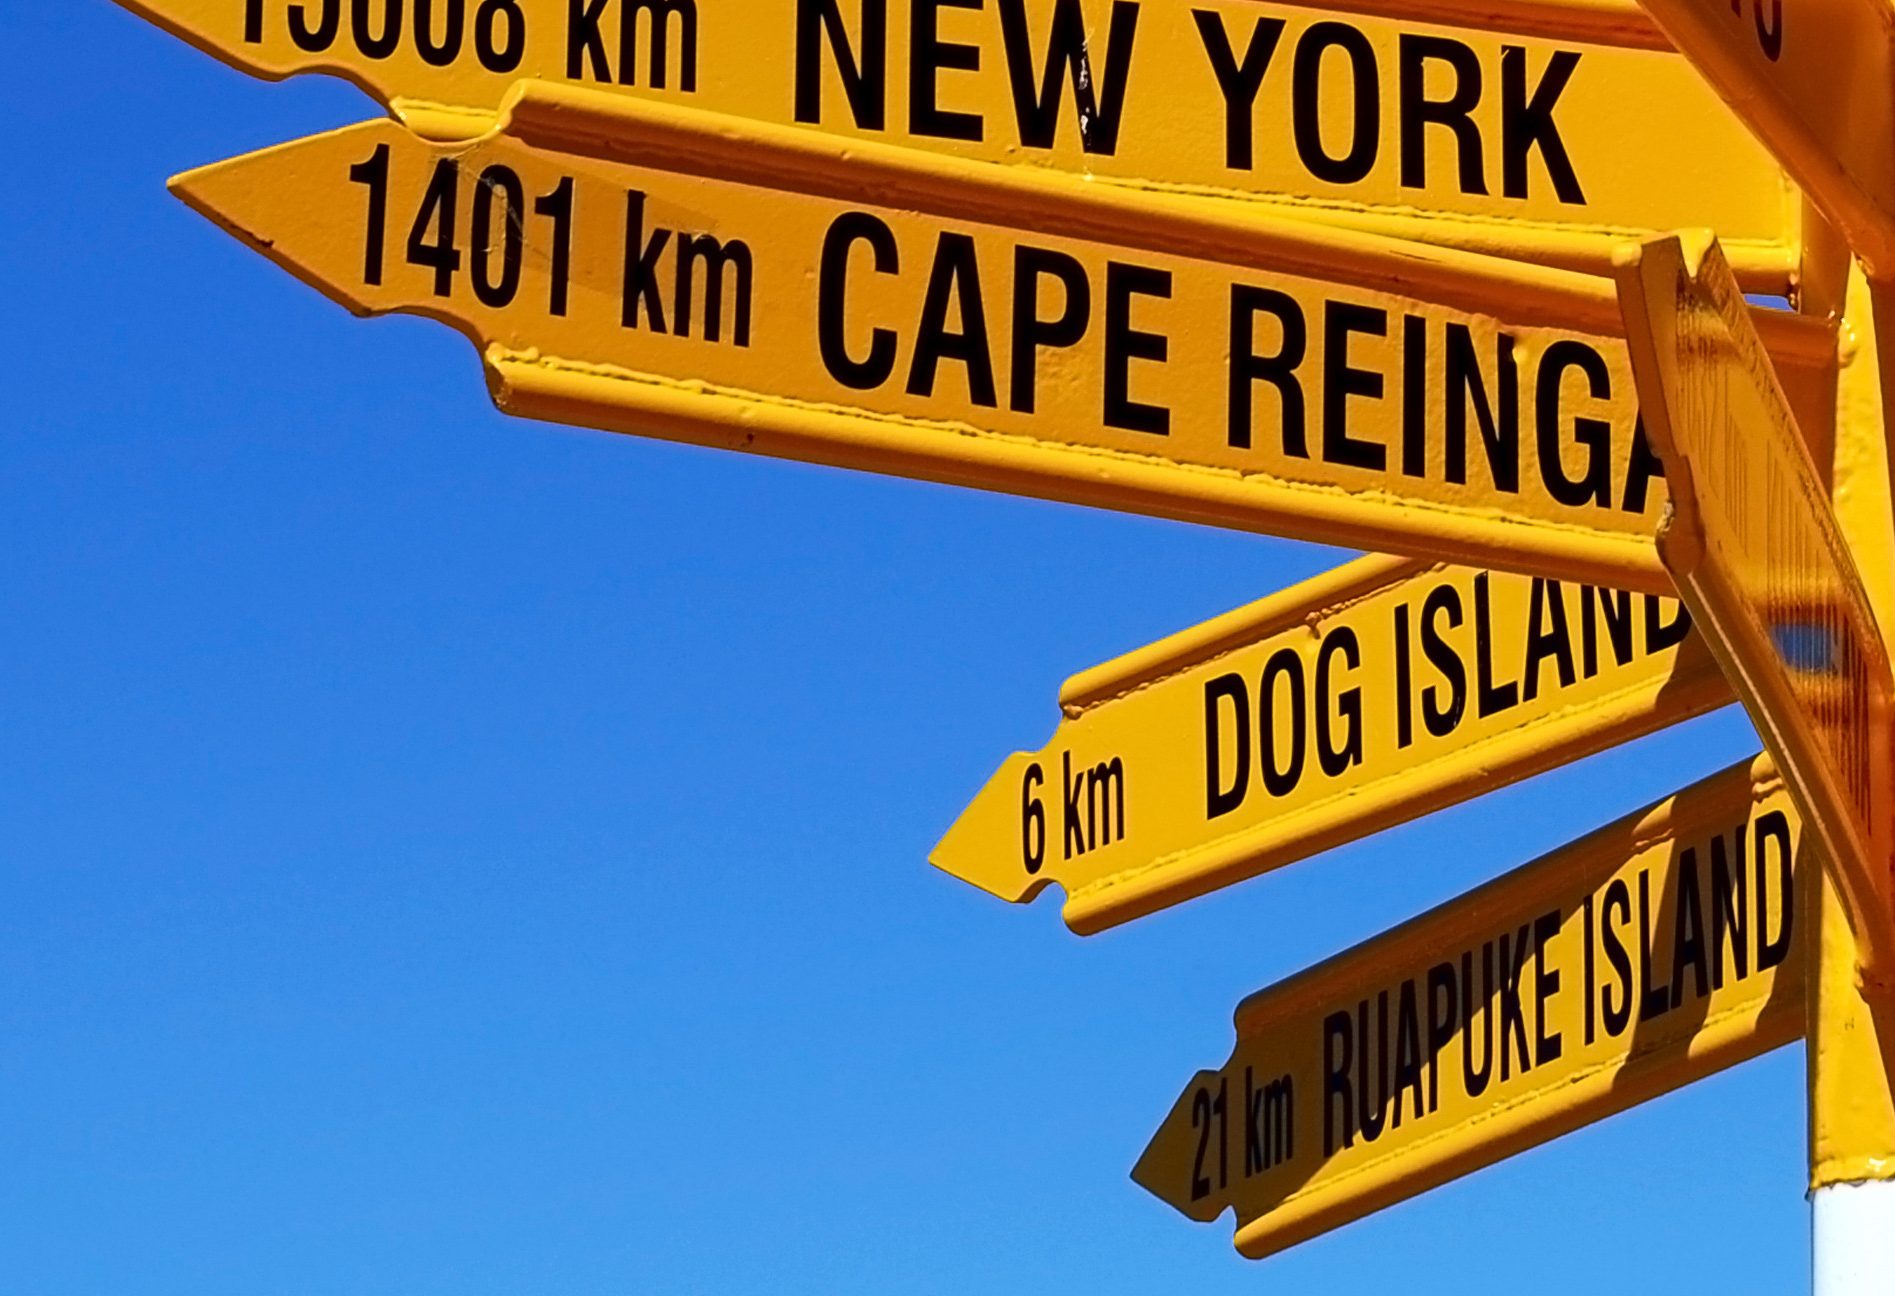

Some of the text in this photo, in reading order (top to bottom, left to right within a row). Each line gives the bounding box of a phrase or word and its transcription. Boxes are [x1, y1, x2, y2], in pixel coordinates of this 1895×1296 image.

[1191, 9, 1587, 206] YORK
[350, 143, 576, 317] 1401
[622, 190, 753, 349] km
[818, 212, 1173, 436] CAPE
[1021, 761, 1047, 875] 6
[1062, 749, 1126, 861] km
[1204, 626, 1364, 820] DOG
[1190, 809, 1794, 1202] 21 km RUAPUKE ISLAND
